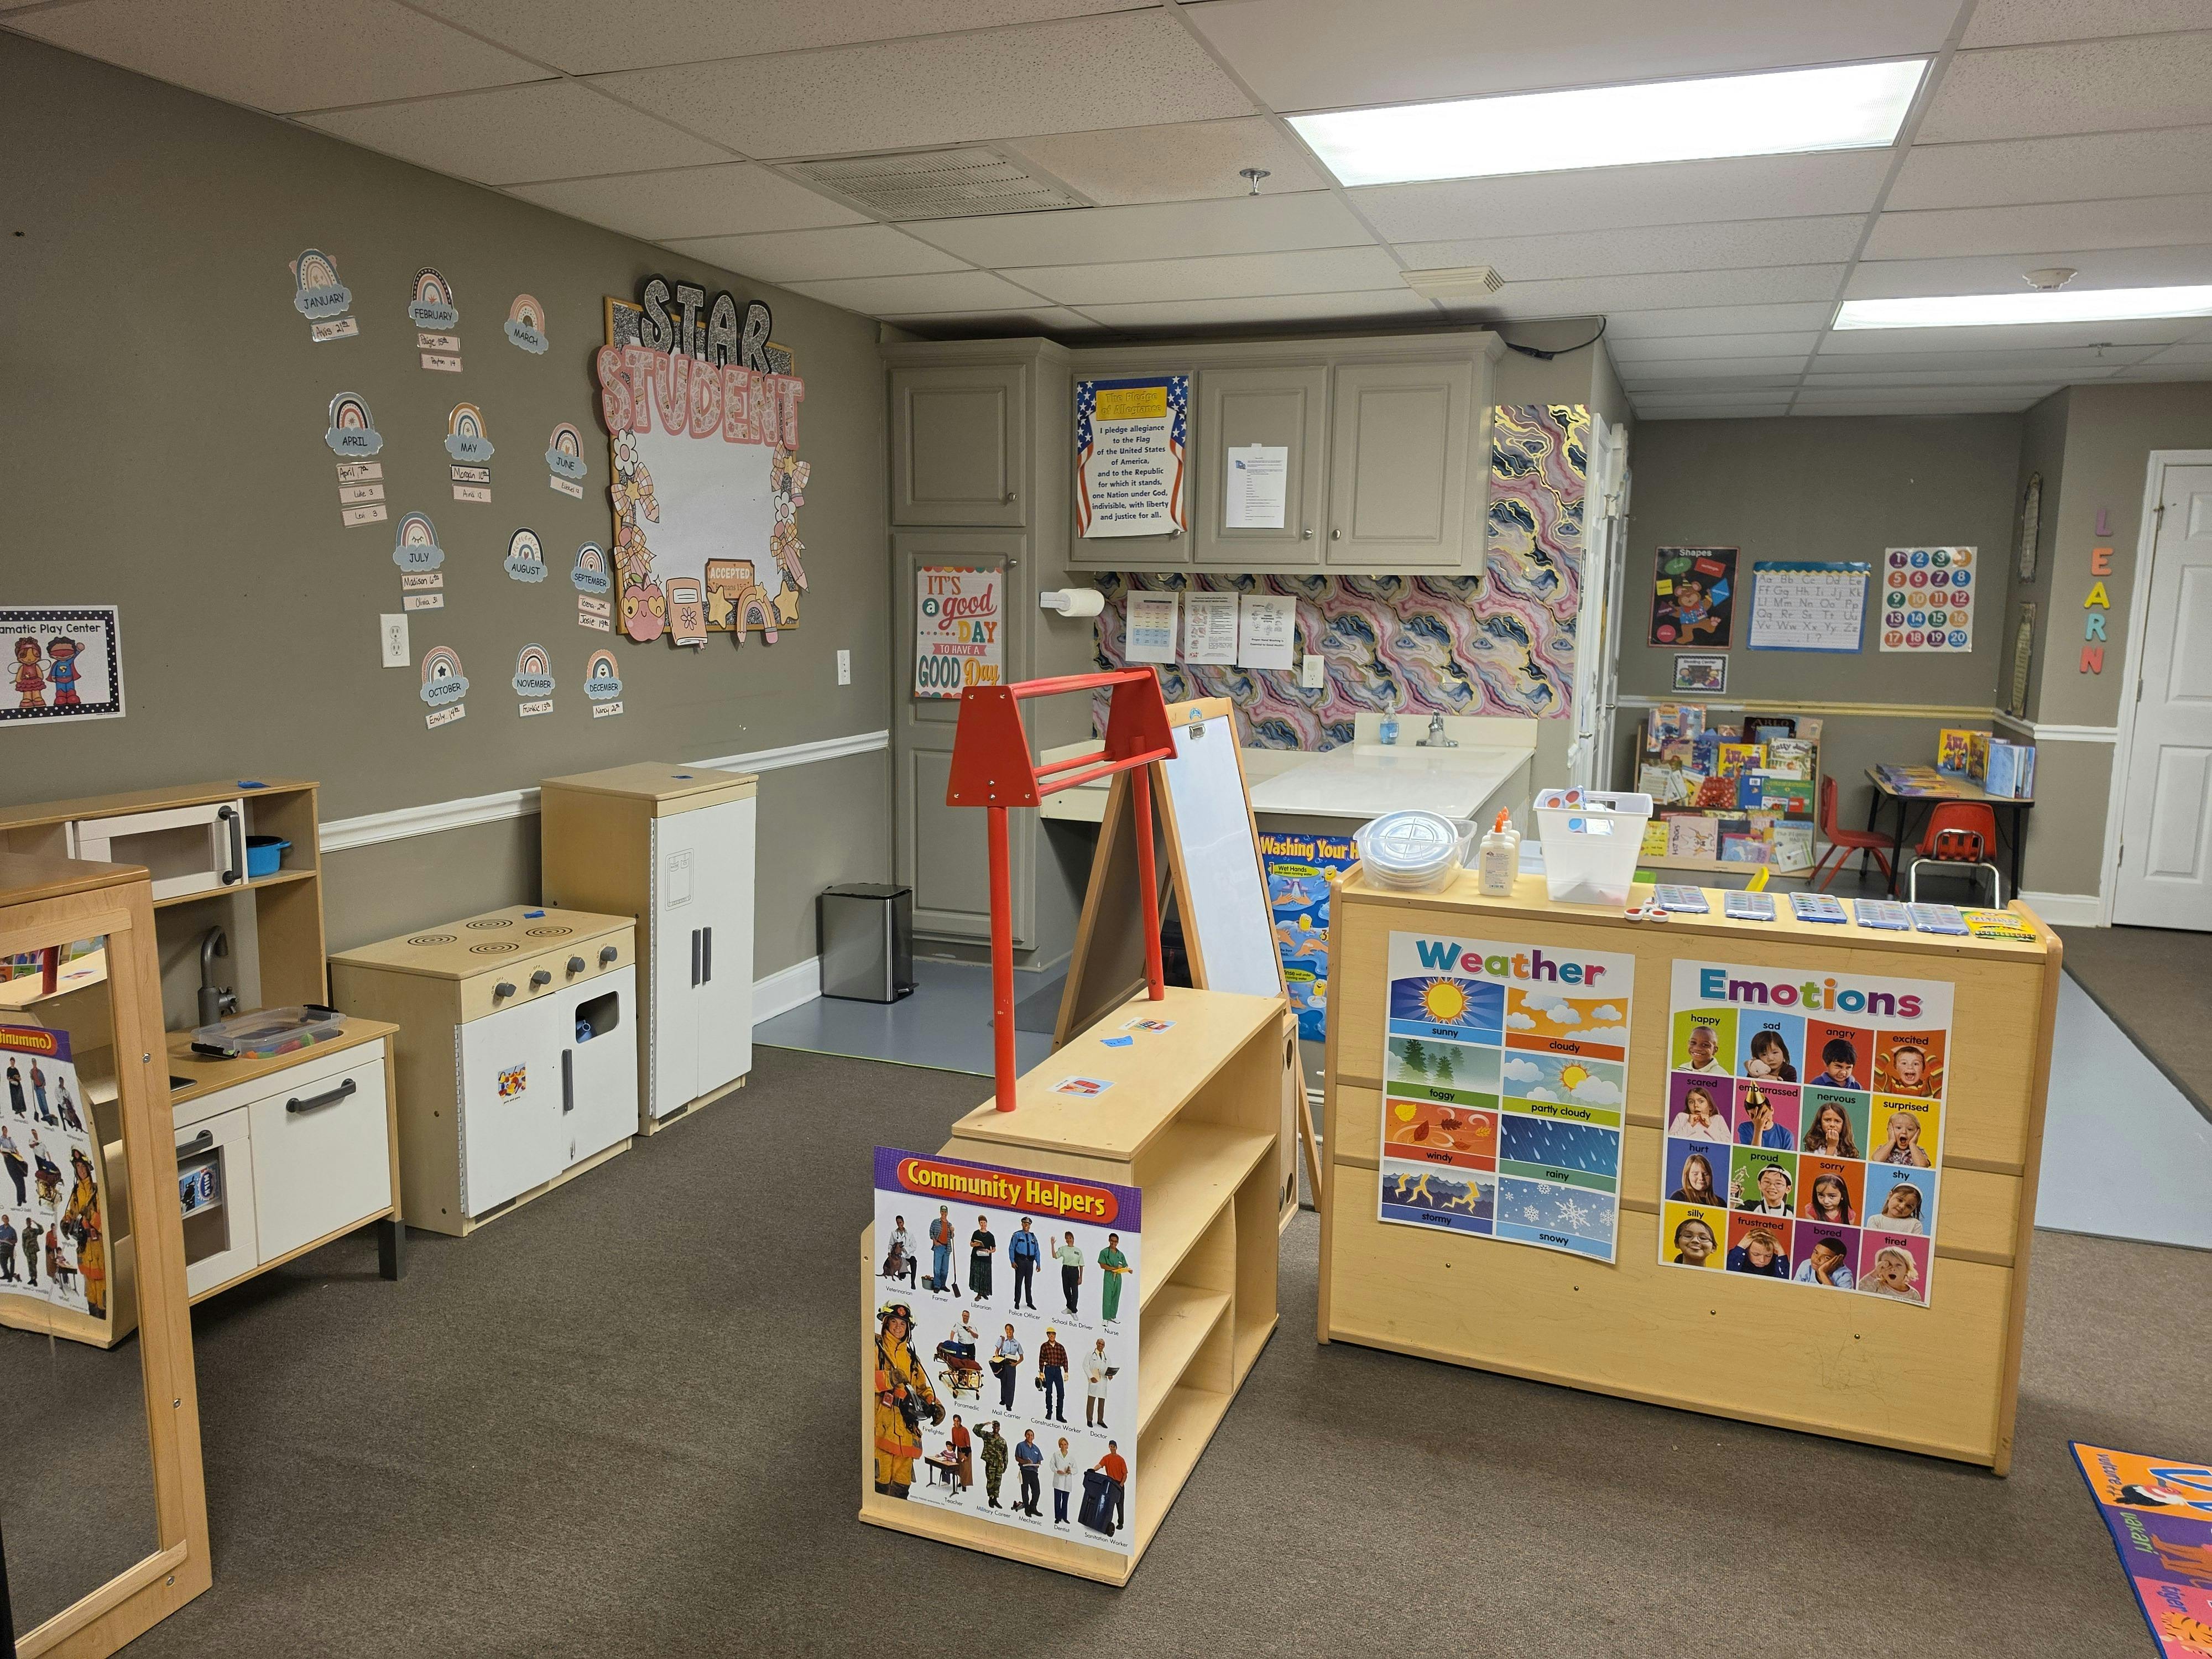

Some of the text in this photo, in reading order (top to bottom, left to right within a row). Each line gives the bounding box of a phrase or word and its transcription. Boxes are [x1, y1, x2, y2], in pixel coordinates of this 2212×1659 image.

[304, 292, 345, 310] JANUARY
[414, 308, 452, 321] FEBRUARY
[641, 276, 773, 378] STAR
[513, 328, 539, 346] MARCH
[598, 346, 804, 449] STUDENT
[1106, 391, 1157, 404] The Pledge
[1101, 404, 1161, 416] of Allegiance
[1104, 426, 1128, 435] pledge
[1130, 425, 1165, 434] allegiance
[342, 436, 368, 447] APRIL
[1136, 436, 1150, 444] Flag
[460, 442, 478, 453] MAY
[556, 456, 575, 471] JUNE
[1120, 457, 1150, 466] America,
[339, 468, 355, 478] April
[1138, 479, 1162, 487] stands,
[353, 489, 367, 498] Luke
[1092, 502, 1126, 510] indivisible,
[1146, 500, 1169, 509] liberty
[409, 553, 430, 563] JULY
[1679, 549, 1713, 557] Shapes
[1916, 552, 1923, 562] 2
[511, 564, 541, 576] AUGUST
[710, 567, 750, 579] ACCEPTED
[1958, 571, 1965, 581] 8
[404, 576, 428, 587] Madison
[574, 573, 607, 587] SEPTEMBER
[1914, 572, 1922, 582] 6
[927, 575, 961, 595] IT'S
[1955, 592, 1966, 602] 12
[2079, 508, 2114, 675] LEARN
[926, 583, 997, 630] a good
[580, 614, 594, 625] Josie
[1932, 612, 1944, 622] 15
[0, 623, 101, 635] amatic Play Center
[957, 620, 998, 643] DAY
[1950, 632, 1965, 641] 20
[940, 645, 980, 655] TO HAVE A
[919, 655, 1000, 688] GOOD Day
[517, 679, 551, 688] NOVEMBER
[589, 683, 619, 692] DECEMBER
[428, 682, 462, 698] OCTOBER
[523, 705, 540, 713] Frankie
[429, 714, 445, 724] Emily
[1260, 836, 1316, 862] Washing
[1316, 838, 1349, 859] Your
[1269, 862, 1274, 874] 1
[1322, 929, 1327, 941] 3
[1416, 940, 1606, 987] Weather
[1700, 968, 1922, 1018] Emotions
[1690, 1013, 1720, 1026] happy
[1762, 1020, 1781, 1030] sad
[1432, 1027, 1459, 1039] sunny
[1825, 1028, 1855, 1040] angry
[1892, 1034, 1929, 1045] excited
[1549, 1041, 1580, 1053] cloudy
[1686, 1077, 1718, 1088] scared
[1429, 1088, 1455, 1101] foggy
[1738, 1082, 1798, 1098] embarrassed
[1817, 1093, 1856, 1104] nervous
[1531, 1104, 1591, 1120] partly cloudy
[1883, 1099, 1929, 1113] surprised
[1689, 1143, 1709, 1154] hurt
[1426, 1151, 1453, 1163] windy
[1750, 1152, 1779, 1162] proud
[1819, 1161, 1845, 1173] sorry
[1546, 1169, 1569, 1182] rainy
[1892, 1170, 1910, 1182] shy
[908, 1161, 1105, 1217] Community Helpers
[1421, 1212, 1452, 1225] stormy
[1687, 1208, 1704, 1220] silly
[1737, 1217, 1784, 1230] frustrated
[1813, 1226, 1842, 1238] bored
[1539, 1233, 1569, 1246] snowy
[1884, 1236, 1907, 1246] tired
[885, 1285, 913, 1296] Veterinarian
[971, 1302, 992, 1311] Librarian
[1008, 1308, 1041, 1321] Police Officer
[1051, 1317, 1068, 1327] School
[1078, 1322, 1093, 1331] Driver
[1104, 1327, 1119, 1337] Nurse
[954, 1400, 979, 1411] Paramedic
[1004, 1411, 1021, 1421] Carrier
[922, 1425, 945, 1437] Firefighter
[1030, 1417, 1082, 1434] Construction Worker
[1090, 1430, 1107, 1439] Doctor
[2096, 1453, 2122, 1485] vulture
[945, 1497, 963, 1506] Teacher
[976, 1505, 1011, 1519] Military Career
[1019, 1515, 1042, 1526] Mechanic
[1053, 1524, 1070, 1533] Dentist
[2120, 1511, 2159, 1556] uakari
[1084, 1532, 1128, 1548] Sanitation Worker
[2157, 1585, 2188, 1613] tiger
